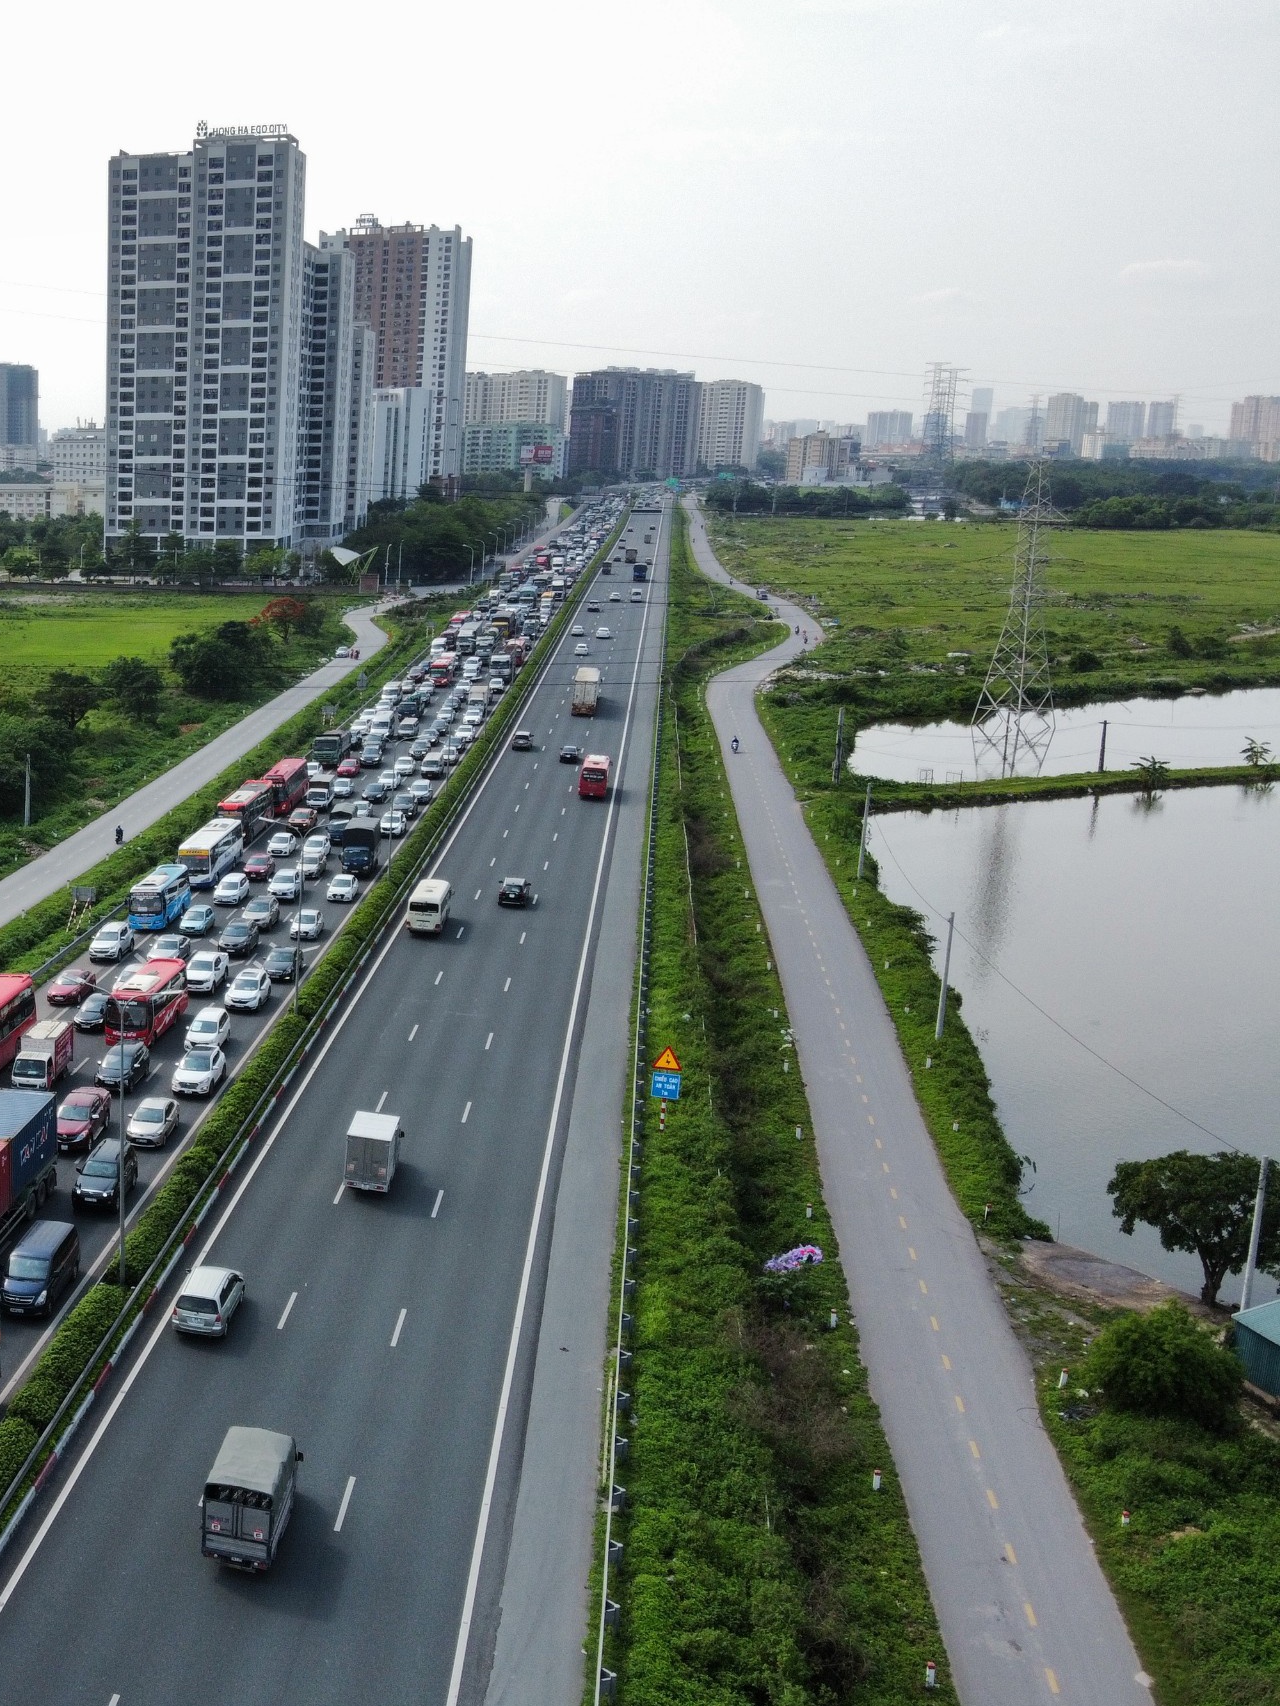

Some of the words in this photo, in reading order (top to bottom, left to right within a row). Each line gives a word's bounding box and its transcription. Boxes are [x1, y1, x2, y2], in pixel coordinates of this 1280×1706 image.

[212, 126, 236, 136] HONG
[237, 126, 249, 135] HA
[269, 124, 287, 133] CITY
